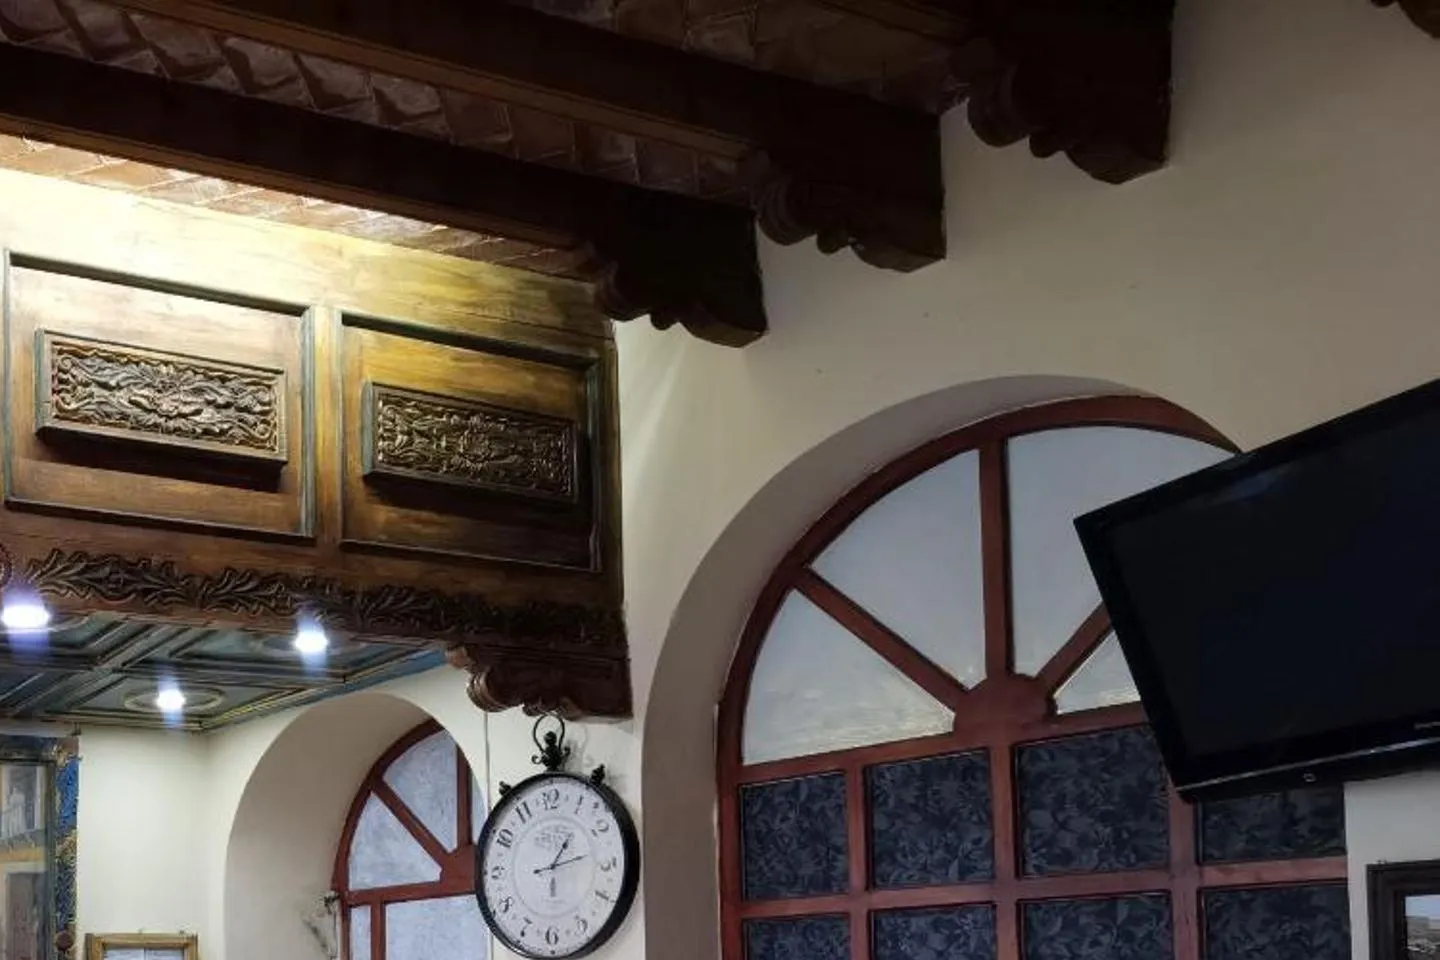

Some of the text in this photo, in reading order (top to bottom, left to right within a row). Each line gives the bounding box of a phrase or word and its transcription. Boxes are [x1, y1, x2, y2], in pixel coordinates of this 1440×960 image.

[542, 788, 560, 811] 12
[573, 795, 584, 815] 1
[515, 801, 533, 824] 11
[496, 828, 514, 849] 10
[590, 818, 610, 838] 2
[600, 857, 617, 872] 3
[519, 916, 533, 938] 7
[545, 925, 560, 946] 6
